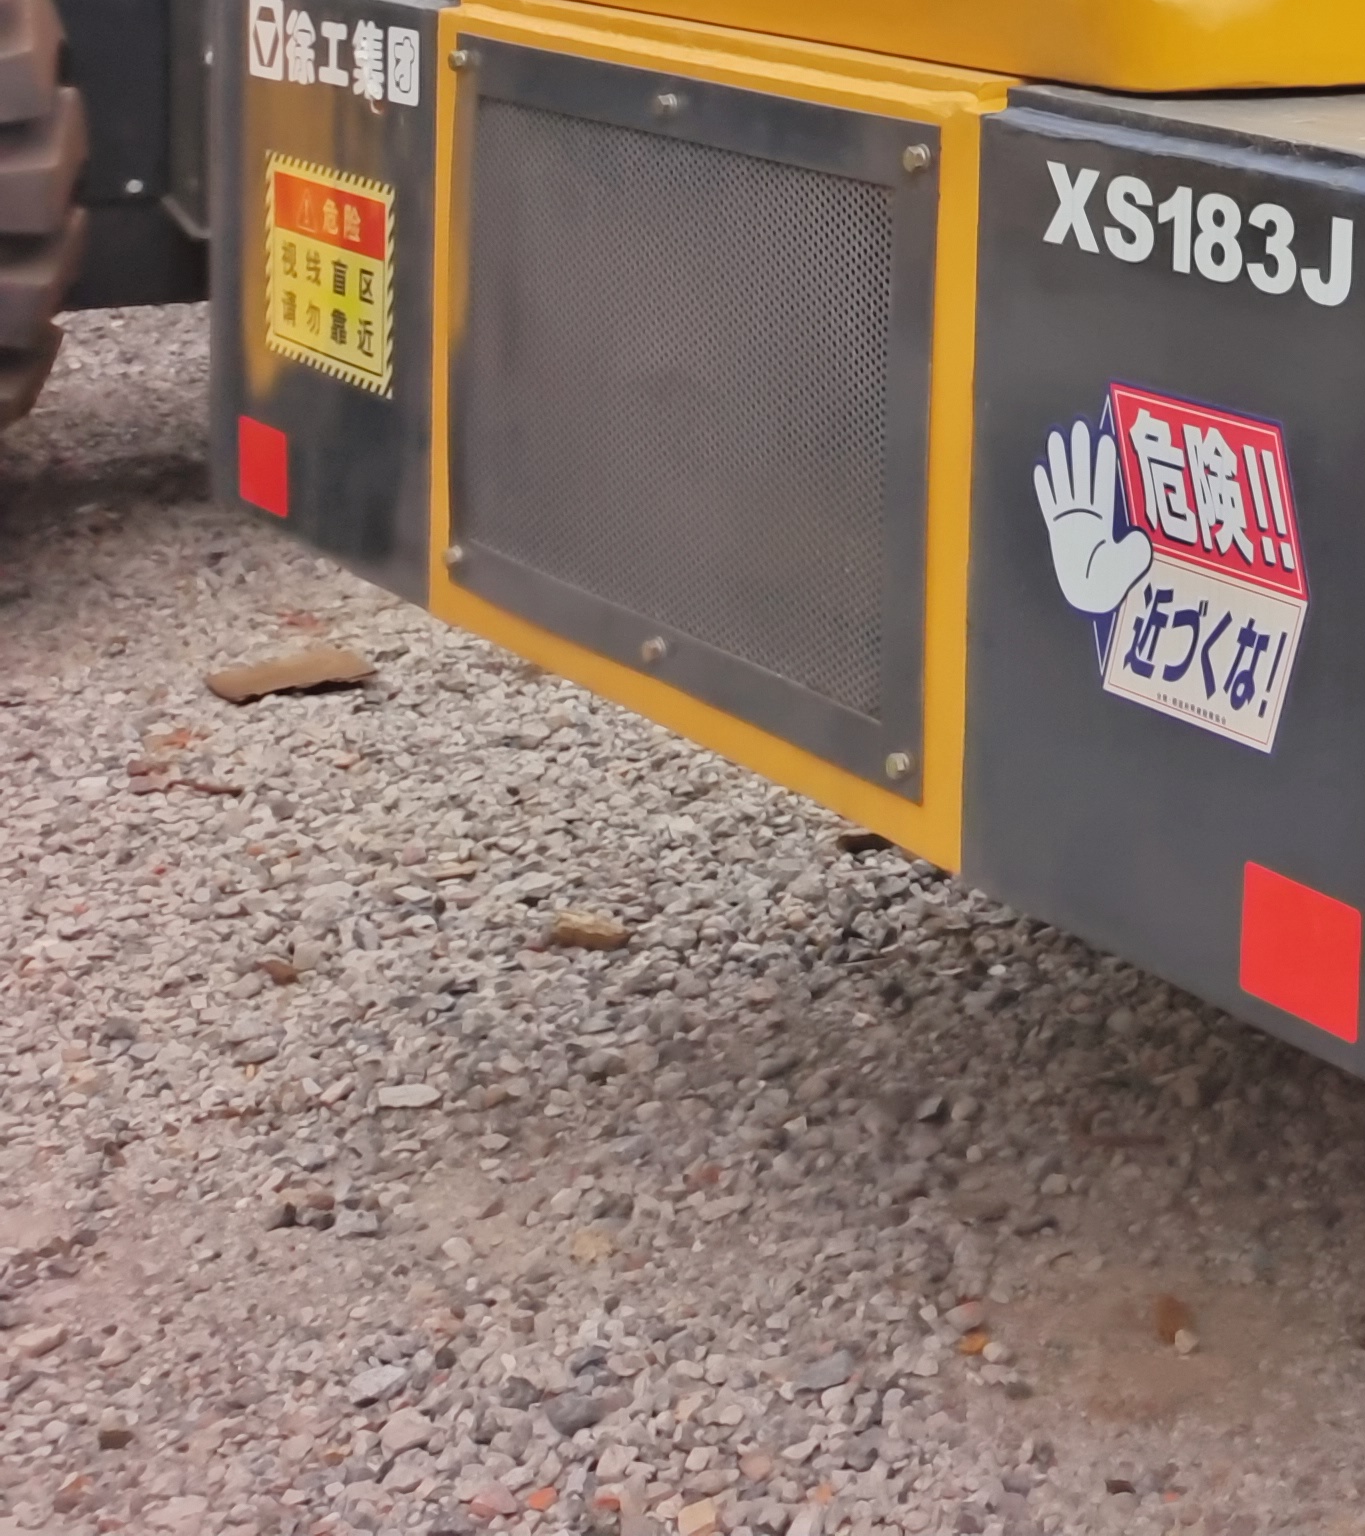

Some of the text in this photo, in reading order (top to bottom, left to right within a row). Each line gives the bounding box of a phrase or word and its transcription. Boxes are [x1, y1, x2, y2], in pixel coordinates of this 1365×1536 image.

[284, 7, 421, 107] 徐工集团
[322, 197, 361, 243] 危险
[1042, 160, 1355, 307] XS183J
